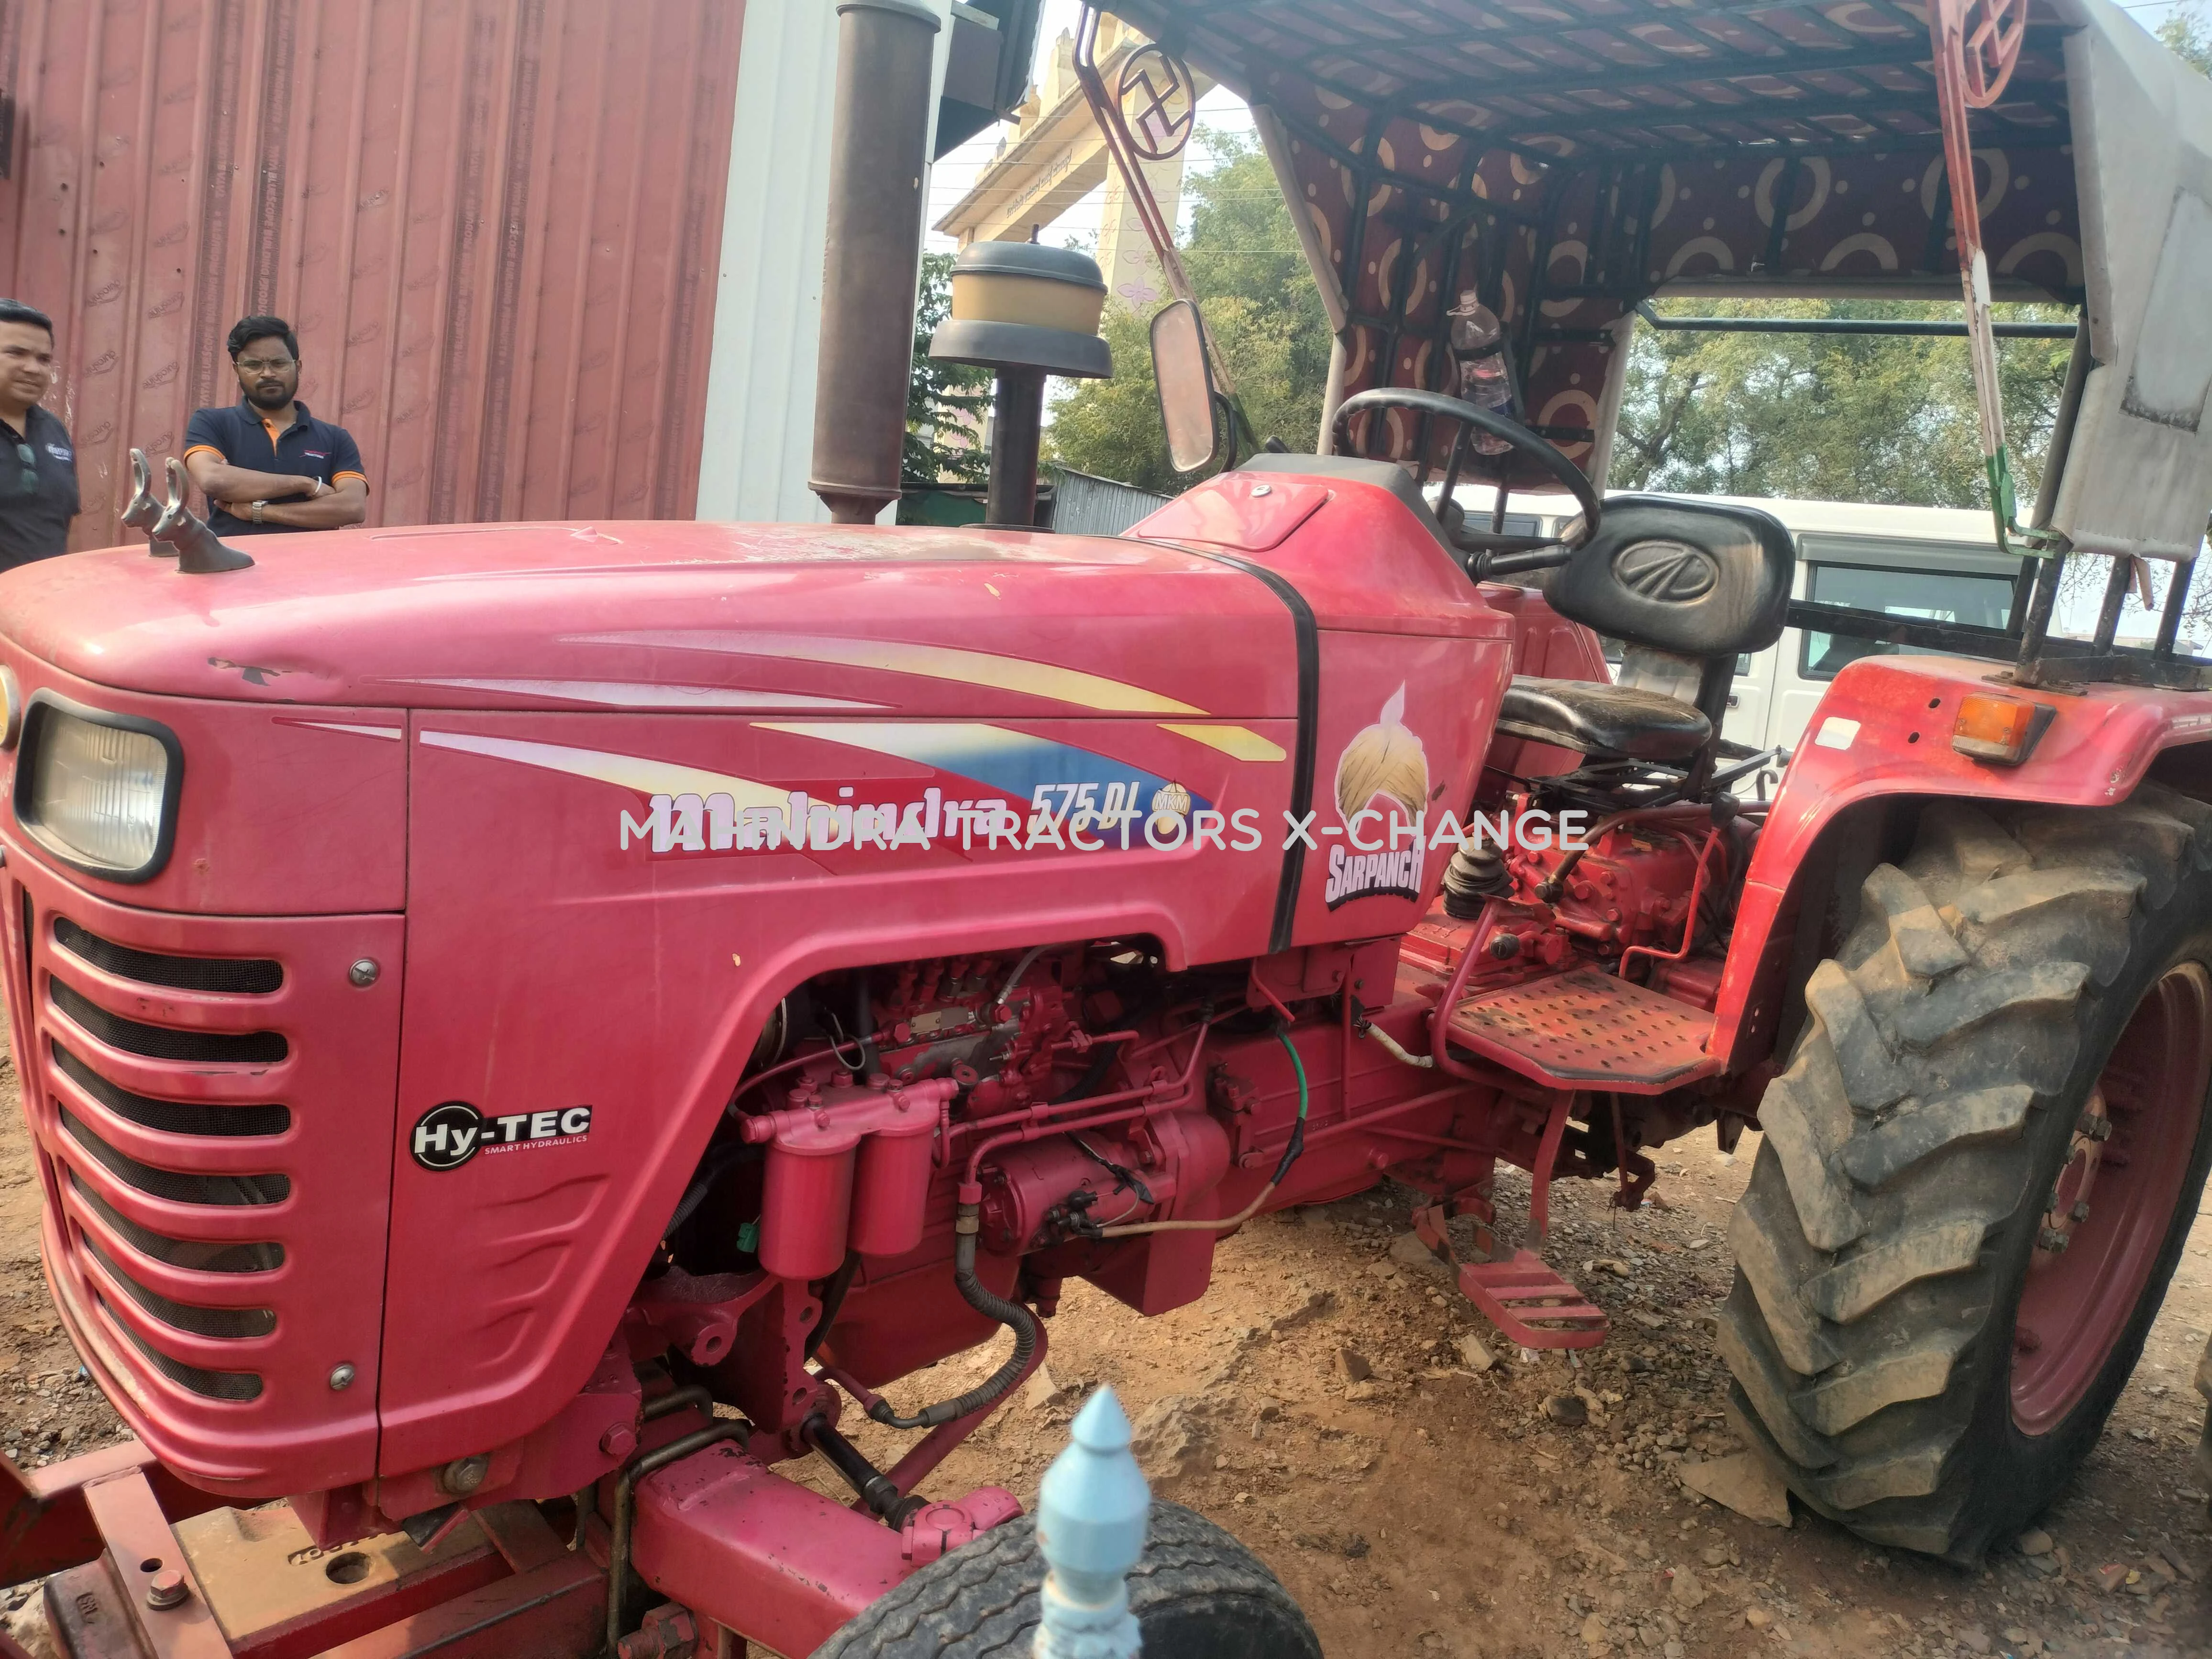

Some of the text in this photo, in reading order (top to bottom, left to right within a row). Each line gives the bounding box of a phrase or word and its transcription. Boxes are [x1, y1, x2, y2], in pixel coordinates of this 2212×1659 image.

[1026, 782, 1100, 835] 575
[1154, 792, 1188, 813] MKM
[414, 1107, 590, 1156] Hy-TEC
[484, 1135, 588, 1154] SMART HYDRAULICS
